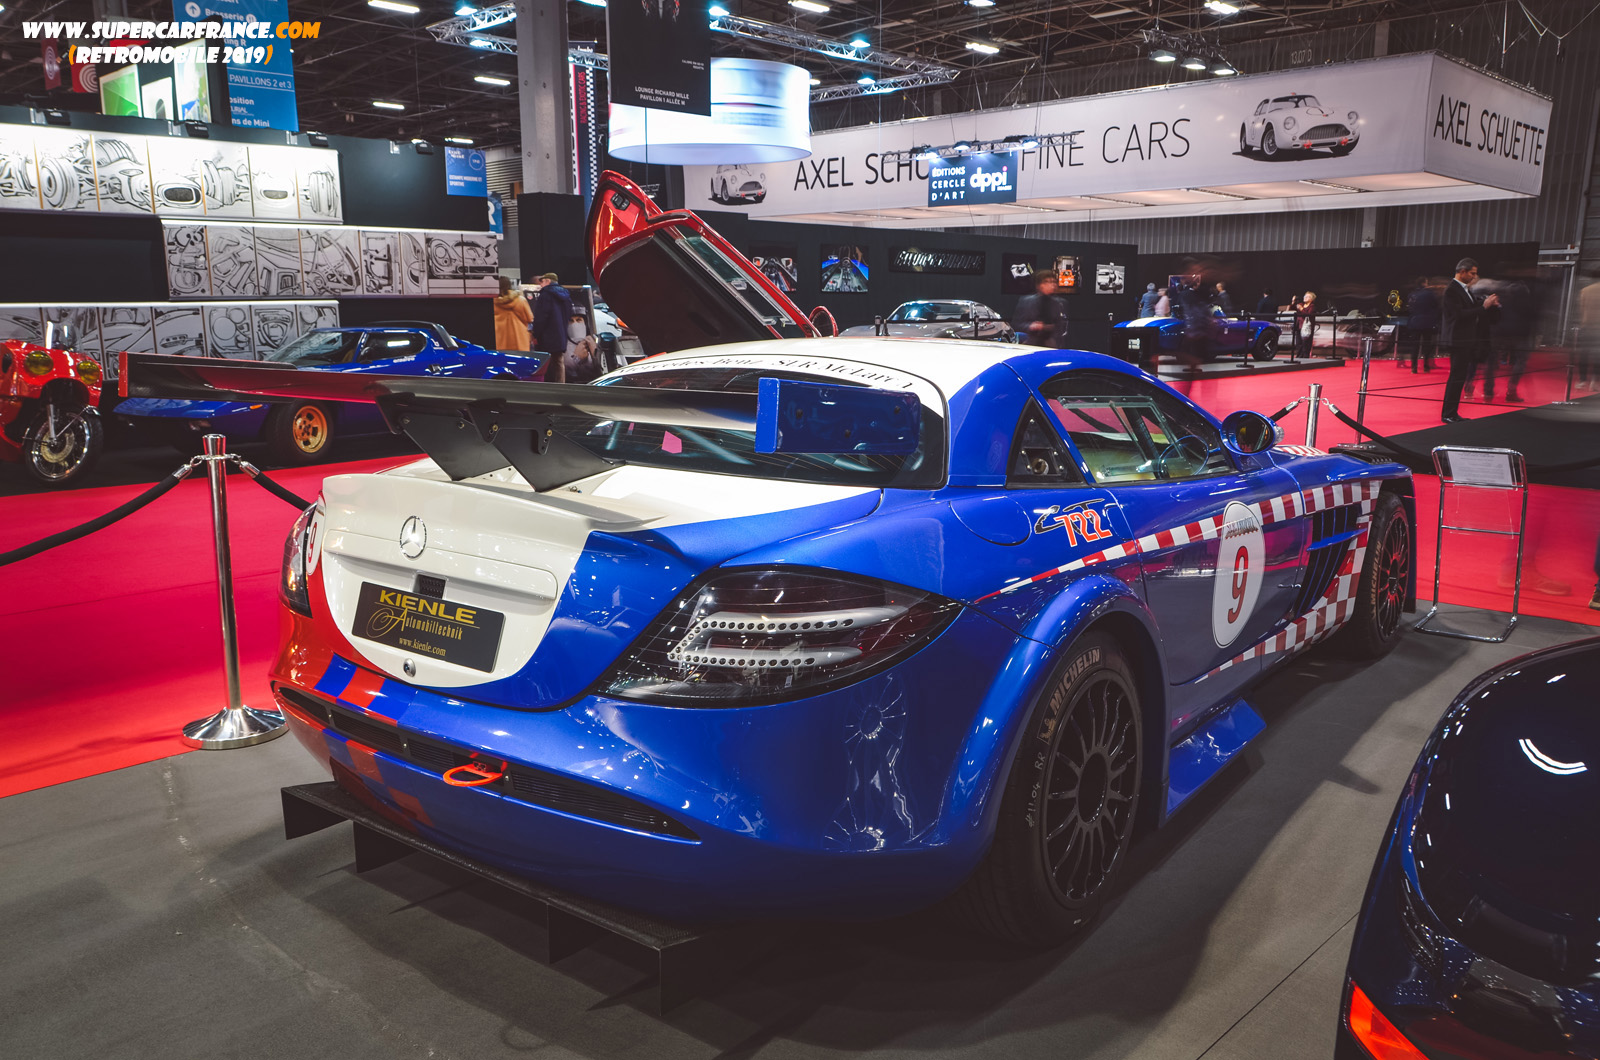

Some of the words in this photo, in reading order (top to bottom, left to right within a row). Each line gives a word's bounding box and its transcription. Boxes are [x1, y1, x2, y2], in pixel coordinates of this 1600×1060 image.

[229, 74, 271, 86] PAVILLONS
[273, 79, 278, 87] 2
[279, 80, 286, 88] et
[287, 80, 292, 88] 3
[634, 86, 654, 94] LOUNGE
[654, 89, 675, 97] RICHARD
[229, 96, 254, 105] osition
[640, 94, 662, 102] PAVILLON
[243, 118, 252, 126] de
[254, 119, 270, 127] Mini
[1433, 94, 1471, 147] AXEL
[1478, 109, 1544, 166] SCHUETTE
[794, 156, 853, 190] AXEL
[865, 152, 930, 185] SCHU
[1102, 118, 1190, 163] CARS
[932, 166, 966, 177] ÉDITIONS
[932, 179, 966, 189] CERCLE
[970, 166, 1008, 192] dppi
[1053, 509, 1113, 547] 722
[307, 521, 317, 563] 9
[1227, 545, 1249, 624] 9
[380, 590, 477, 624] KIENLE
[366, 607, 463, 640] Automobiltechnik
[399, 637, 446, 656] www.kienle.com
[1050, 648, 1100, 716] MICHELIN
